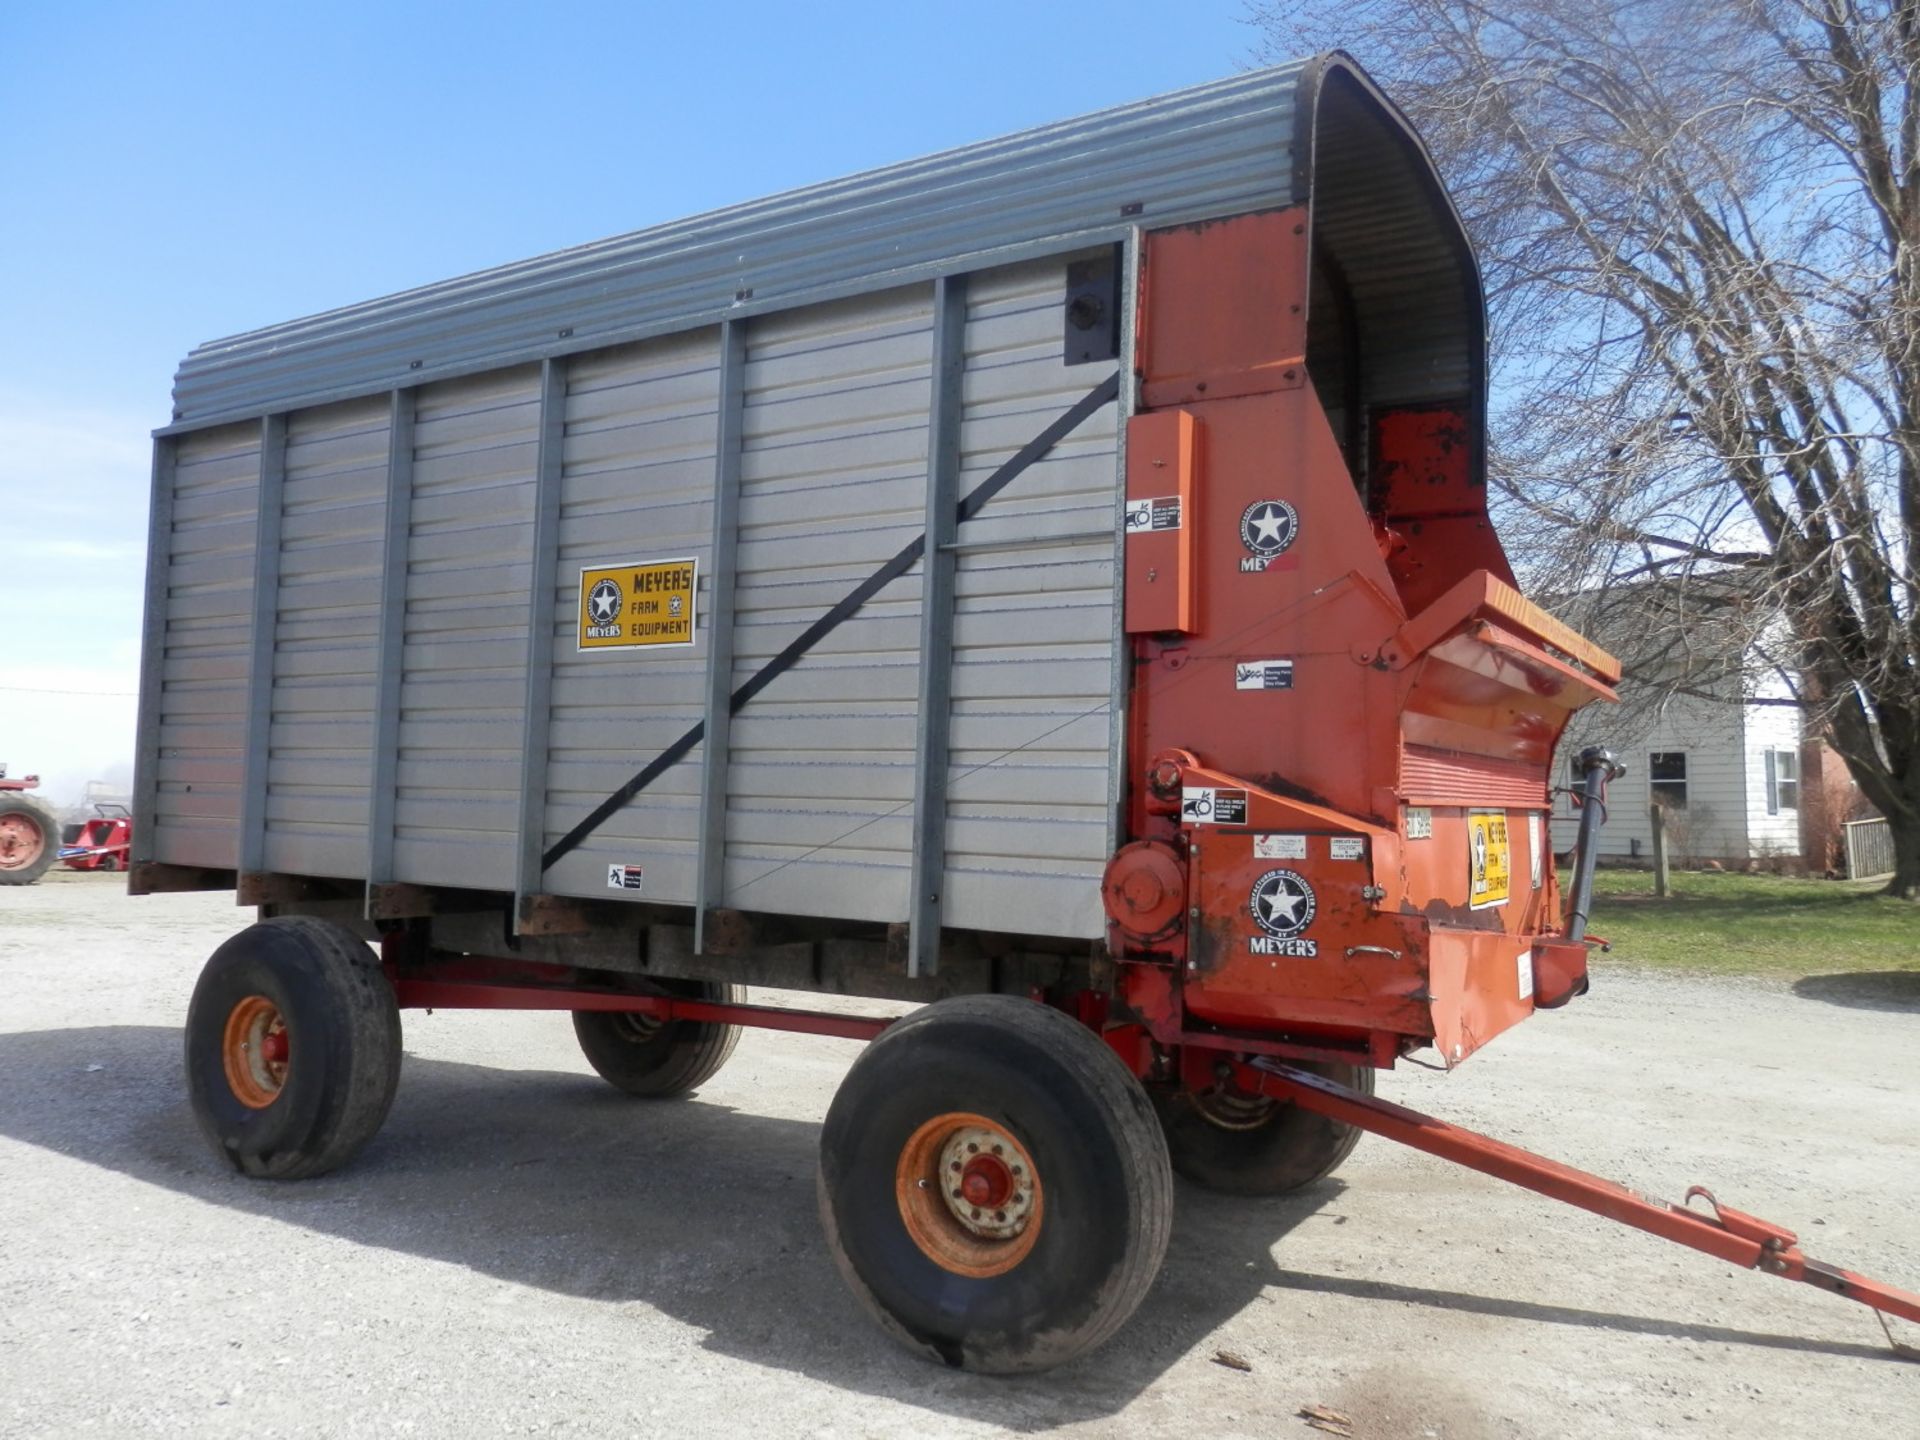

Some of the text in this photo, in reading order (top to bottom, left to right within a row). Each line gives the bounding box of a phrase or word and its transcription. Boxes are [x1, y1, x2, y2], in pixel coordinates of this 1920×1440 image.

[1241, 557, 1272, 572] MEY
[633, 567, 691, 594] MEYER'S
[631, 600, 659, 615] FARM
[631, 620, 689, 636] EQUIPMENT
